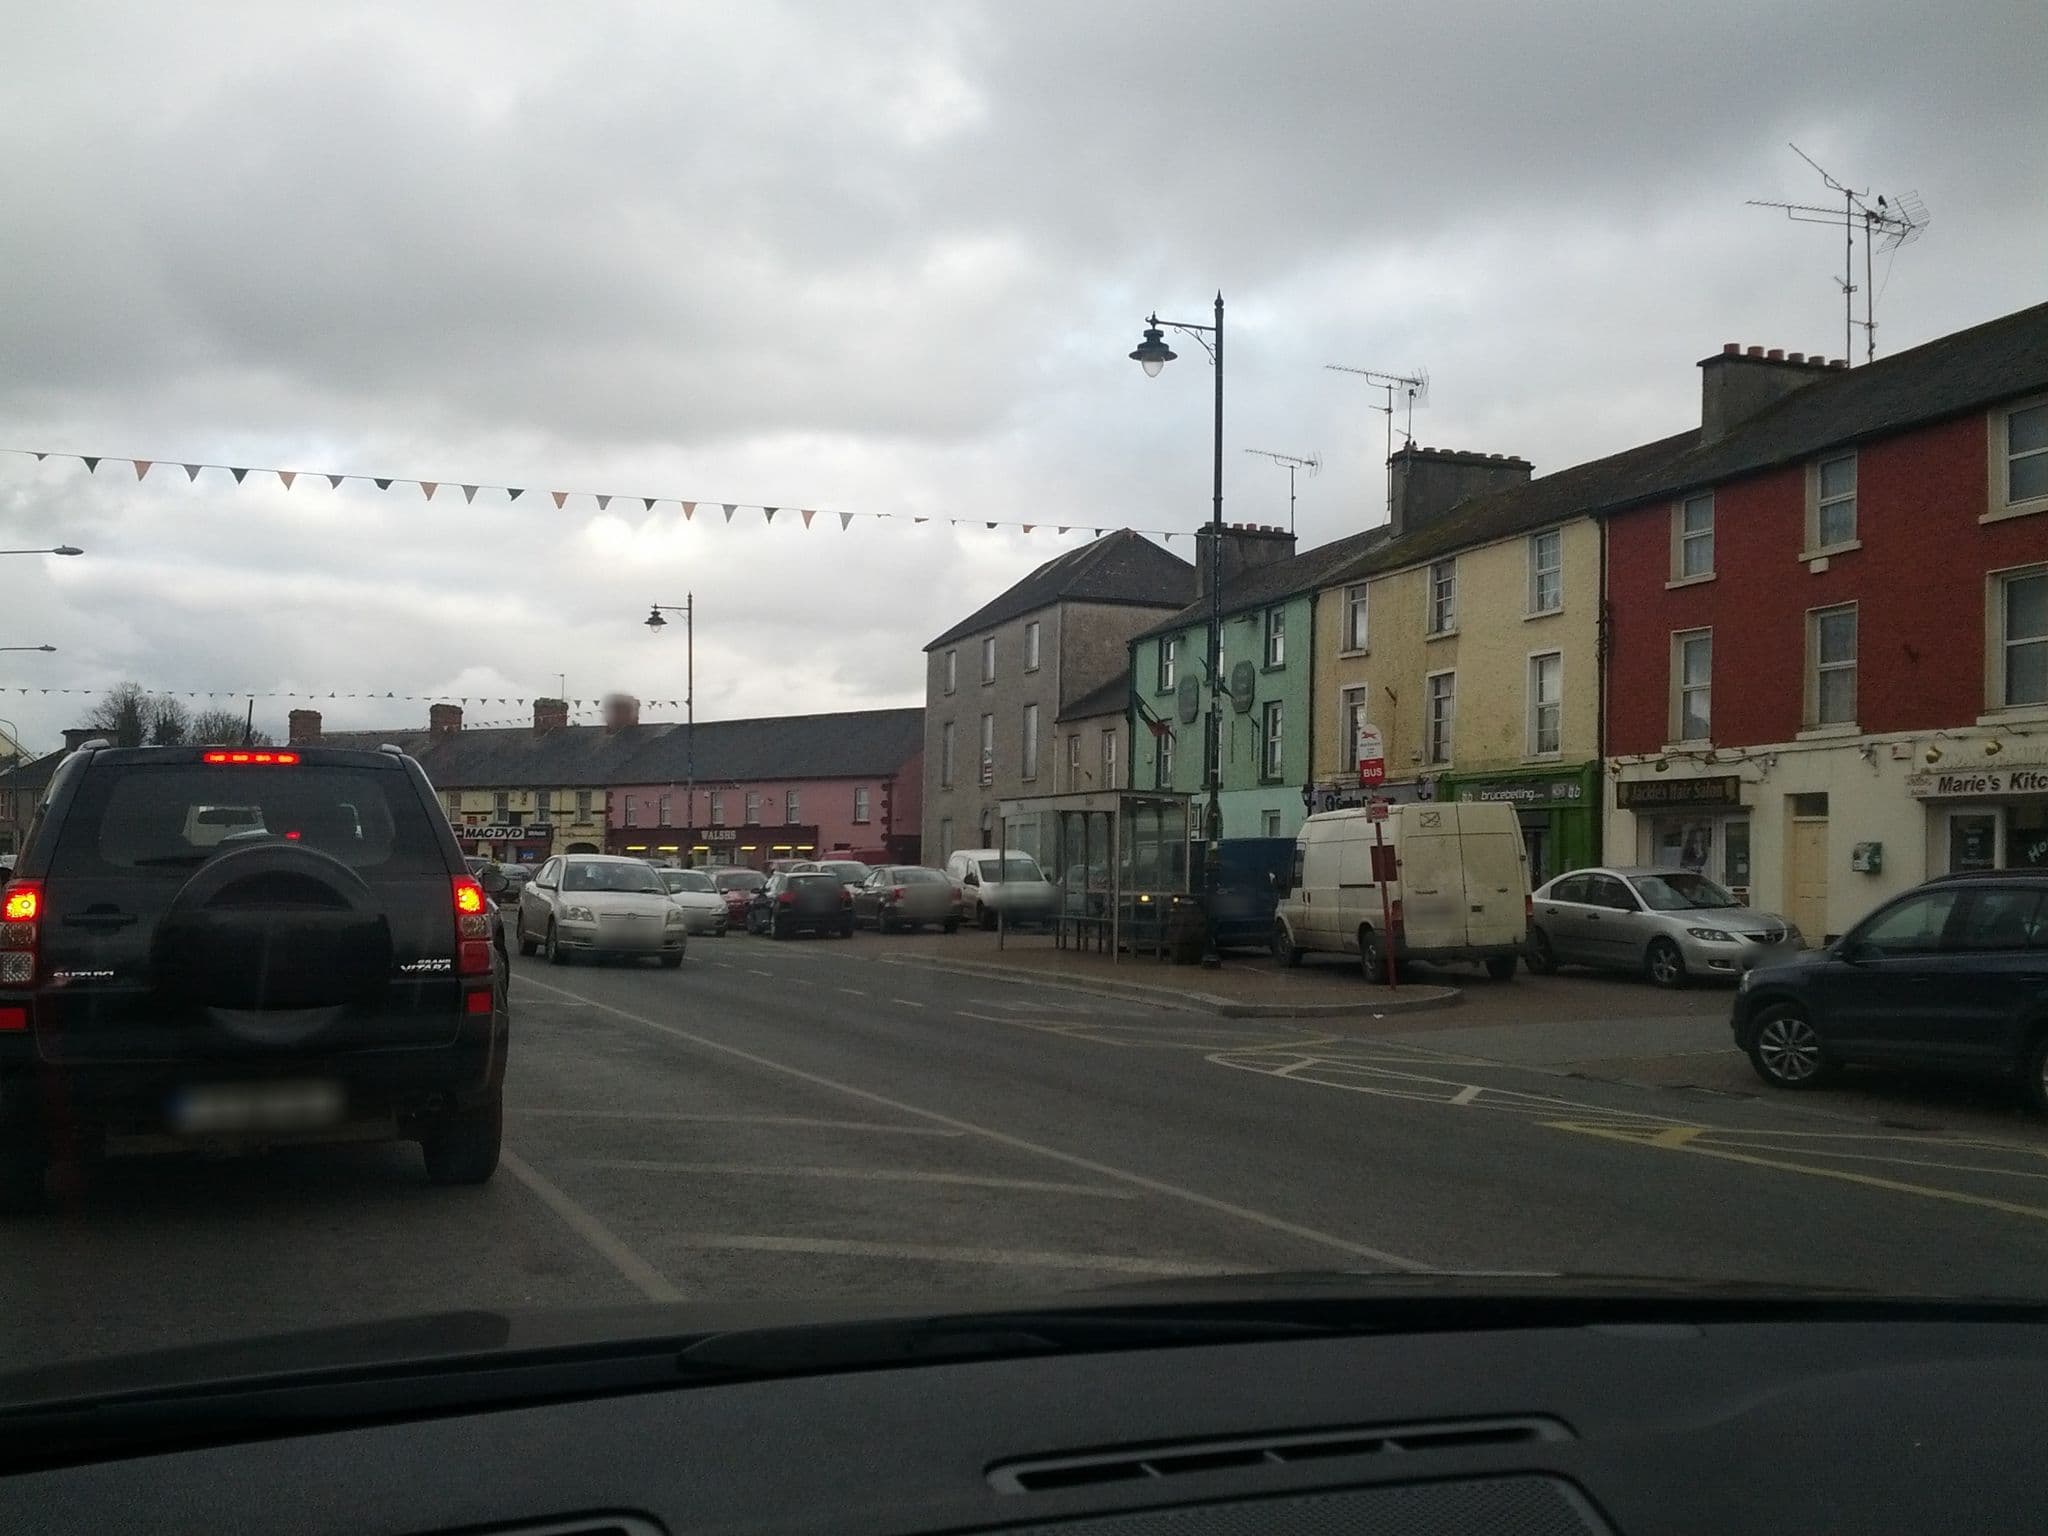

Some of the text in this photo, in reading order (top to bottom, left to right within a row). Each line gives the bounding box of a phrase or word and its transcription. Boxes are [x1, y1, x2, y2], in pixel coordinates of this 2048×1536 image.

[1363, 767, 1383, 778] BUS
[1938, 775, 2001, 794] Marie's
[400, 964, 451, 974] VITARA
